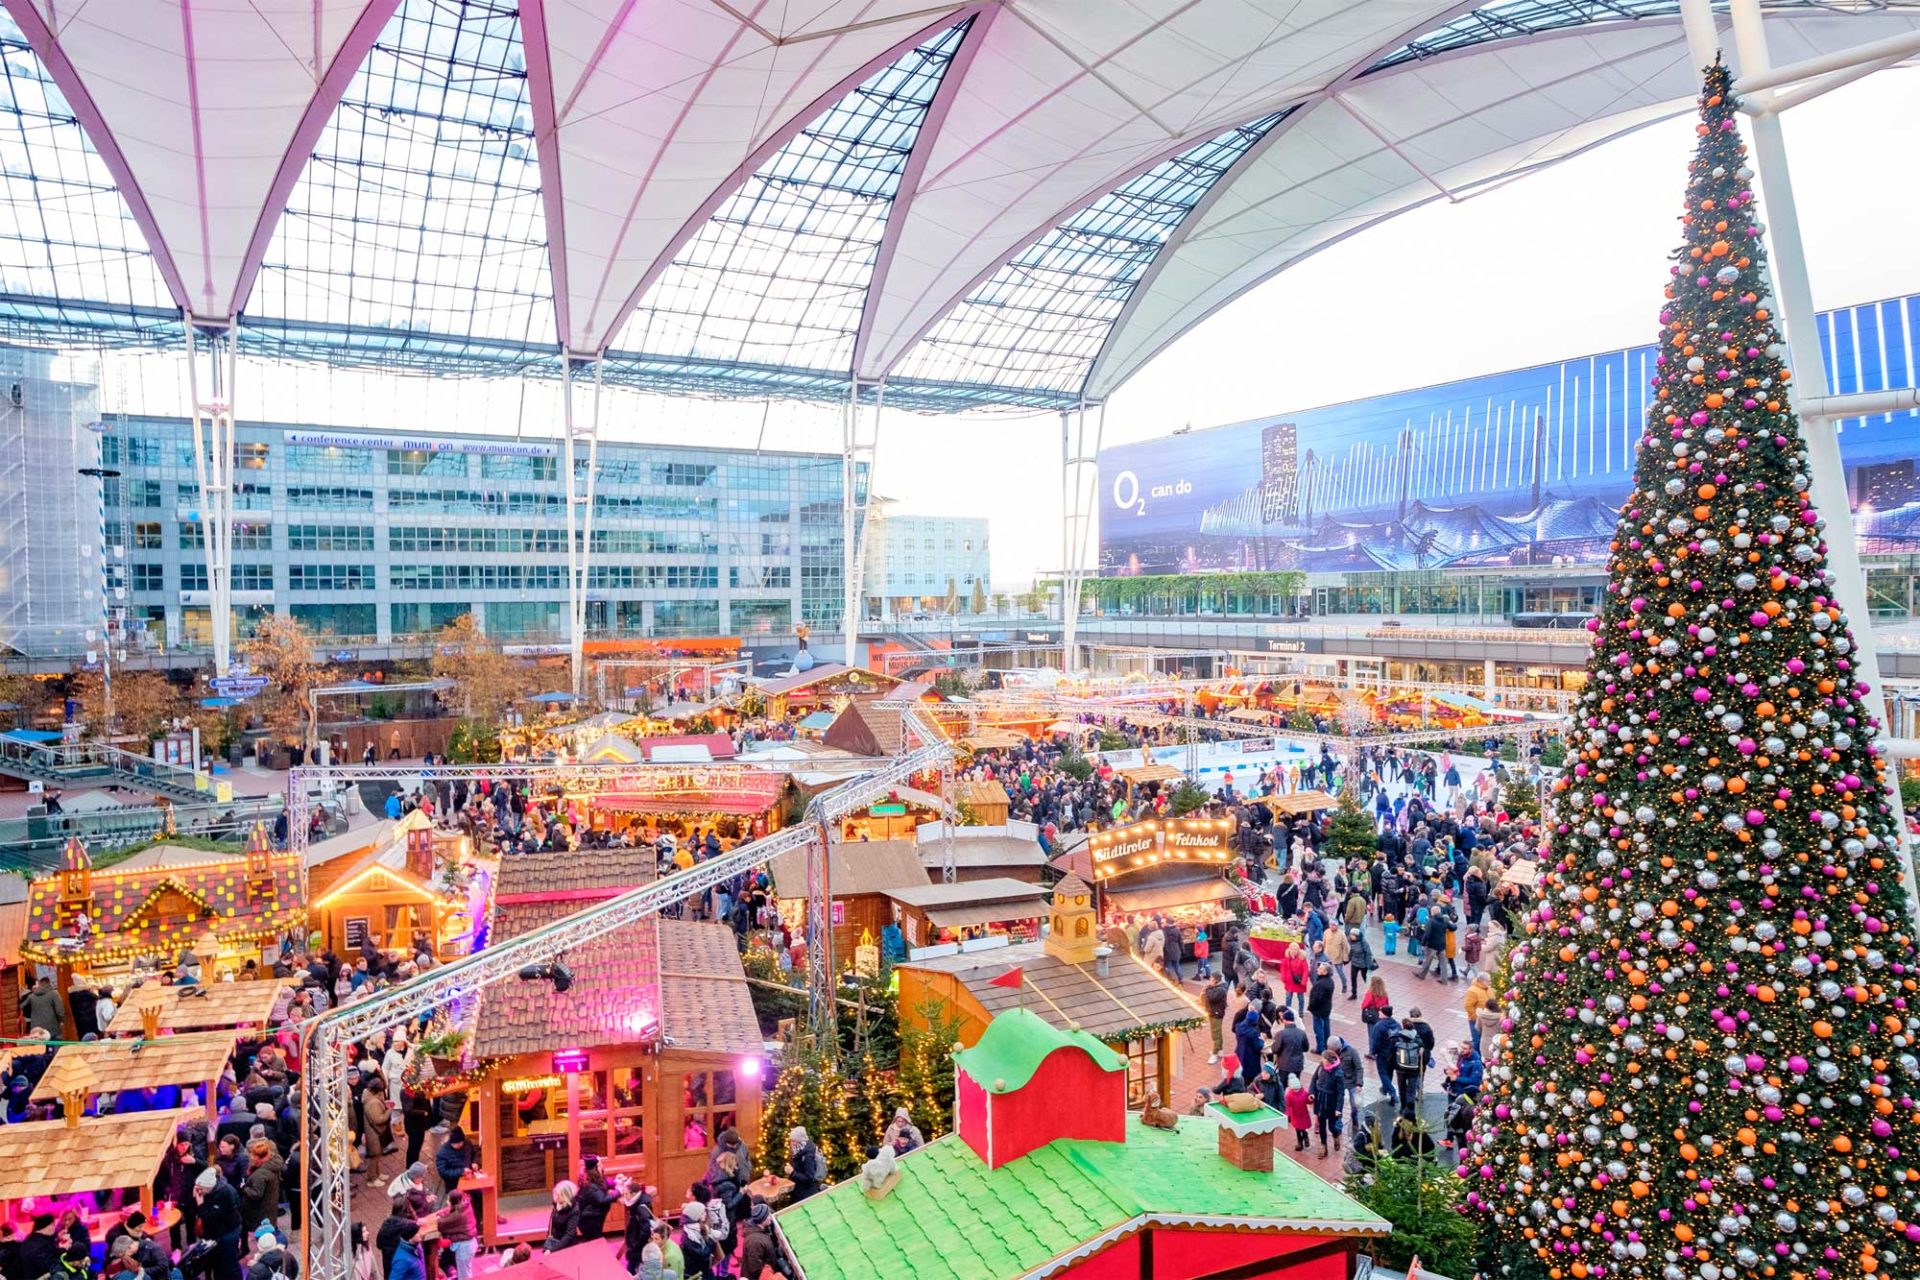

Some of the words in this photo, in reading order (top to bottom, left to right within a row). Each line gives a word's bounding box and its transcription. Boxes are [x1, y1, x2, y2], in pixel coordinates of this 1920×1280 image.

[301, 435, 359, 446] conference
[361, 438, 393, 448] center
[462, 442, 542, 454] www.municon.de
[1151, 485, 1172, 498] can
[1175, 478, 1192, 495] do
[1268, 640, 1299, 651] Terminal
[1300, 641, 1306, 652] 2
[1095, 838, 1152, 862] Südtiroler
[1174, 833, 1219, 847] Feinkost
